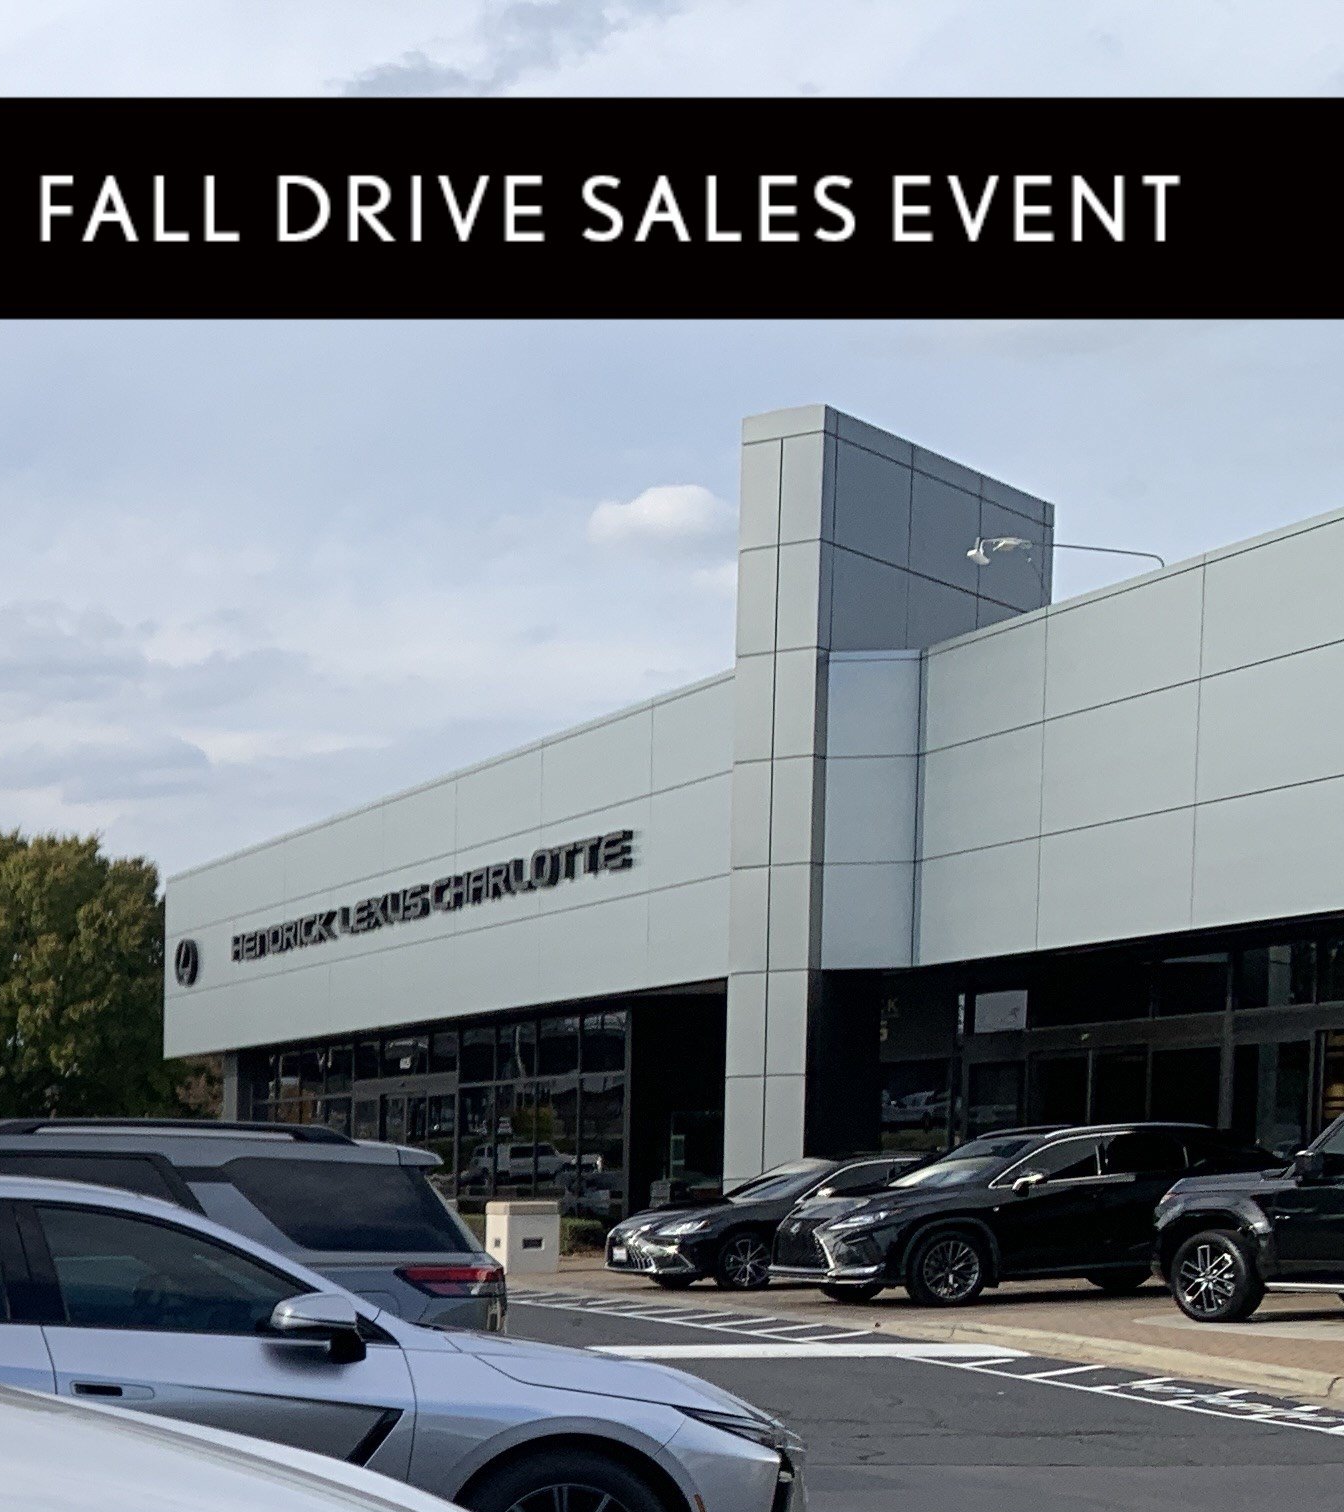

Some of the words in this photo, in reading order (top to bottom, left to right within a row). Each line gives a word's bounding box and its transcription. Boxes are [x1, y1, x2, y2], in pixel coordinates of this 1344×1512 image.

[231, 910, 337, 962] HENDRICK
[339, 884, 430, 935] LEXUS
[430, 830, 633, 912] CHARLOTTE
